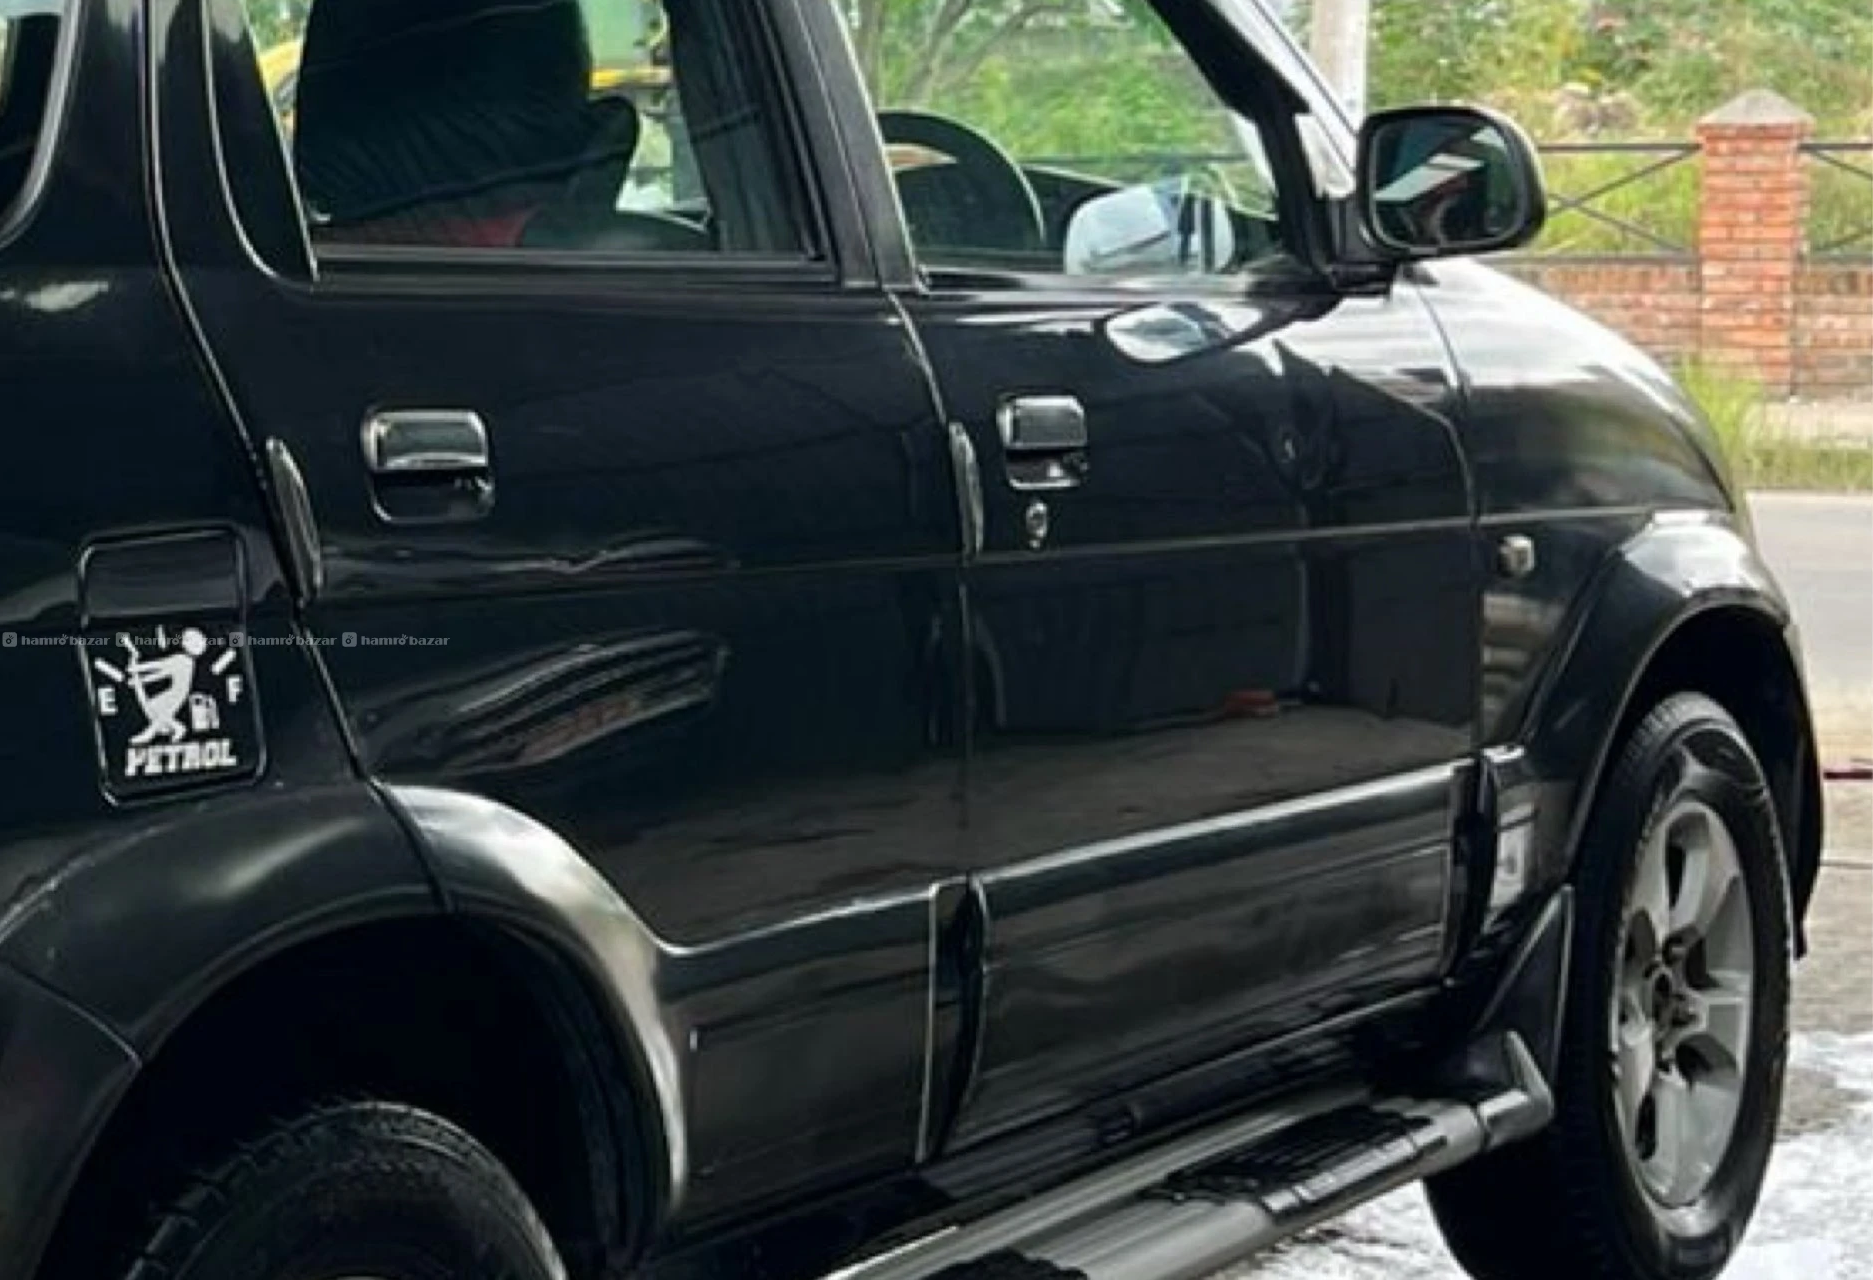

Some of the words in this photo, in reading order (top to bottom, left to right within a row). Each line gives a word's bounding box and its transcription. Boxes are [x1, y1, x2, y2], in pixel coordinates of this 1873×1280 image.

[98, 687, 118, 715] E
[227, 675, 243, 703] F
[125, 738, 237, 776] PETROL
